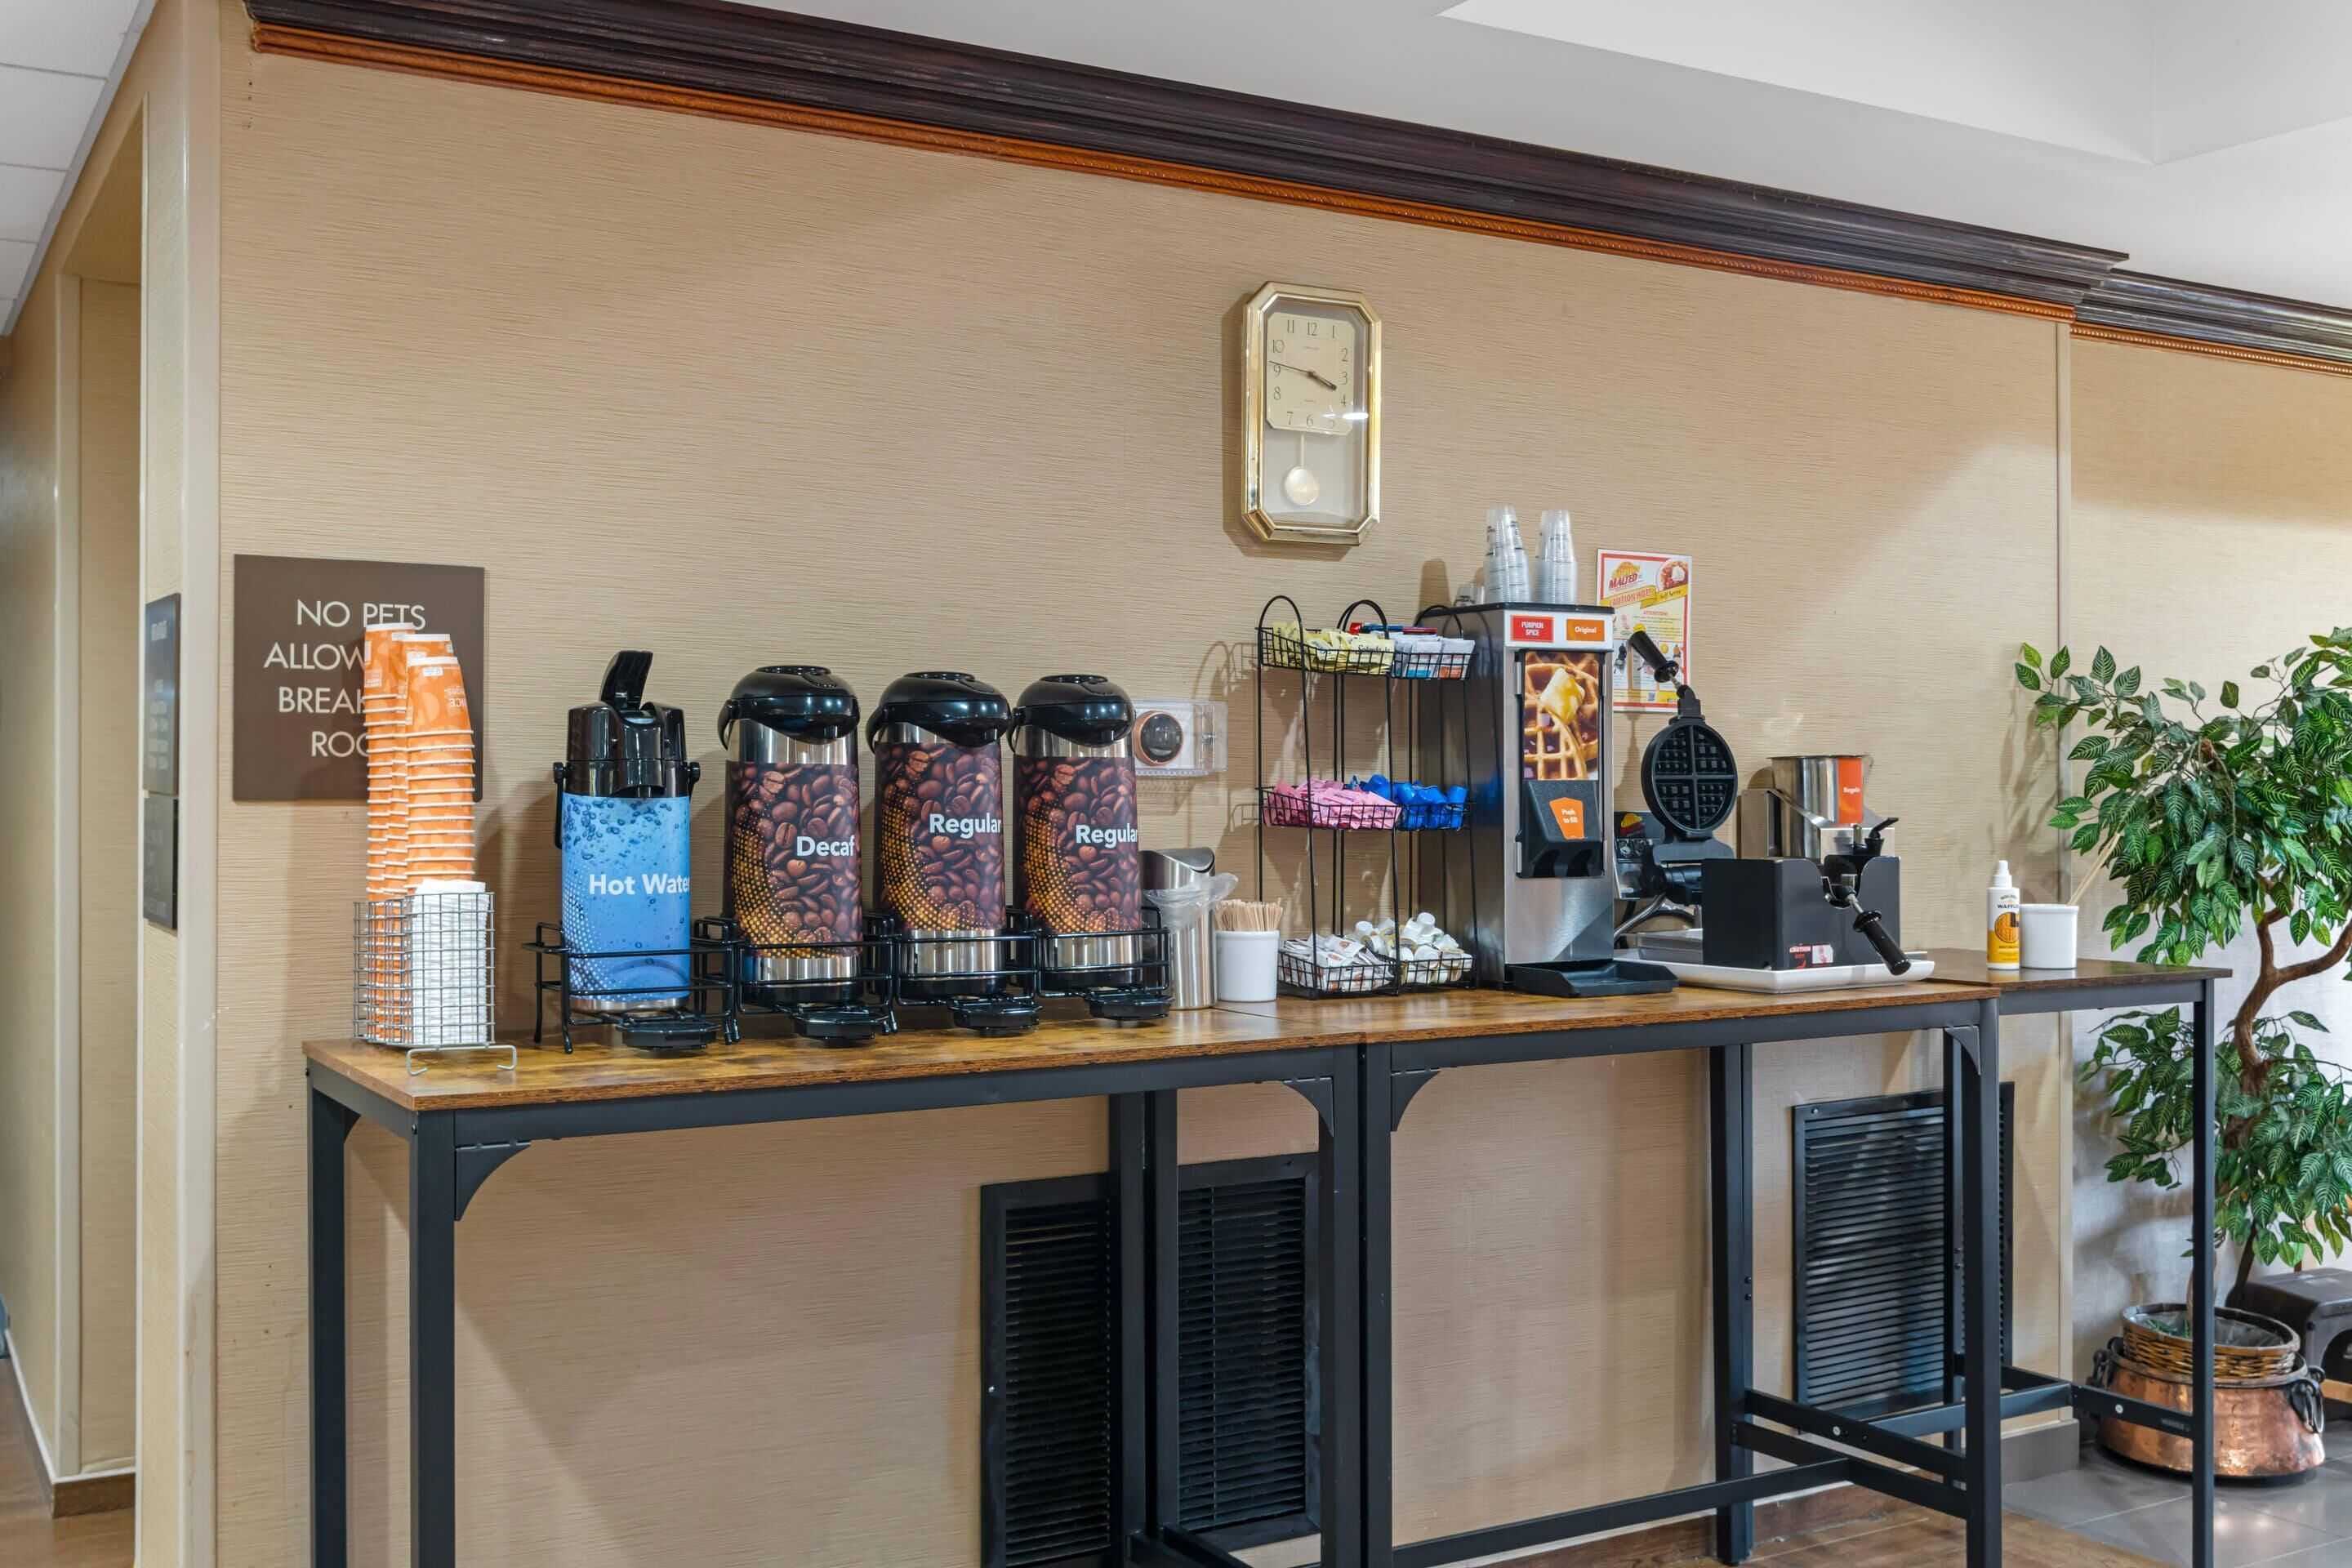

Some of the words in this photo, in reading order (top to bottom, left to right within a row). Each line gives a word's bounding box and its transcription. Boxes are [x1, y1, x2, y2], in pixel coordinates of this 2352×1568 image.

[1287, 319, 1294, 333] 11
[1307, 322, 1318, 336] 12
[1272, 339, 1285, 353] 10
[1341, 347, 1348, 362] 2
[1273, 364, 1281, 376] 9
[1339, 372, 1348, 385] 3
[1273, 386, 1281, 400] 8
[1340, 394, 1347, 408] 4
[1286, 411, 1294, 425] 7
[1306, 414, 1314, 427] 6
[1609, 573, 1638, 589] MALTED
[297, 599, 350, 627] NO
[363, 603, 425, 630] PETS
[1575, 626, 1597, 635] Original
[929, 812, 1002, 839] Regular
[1076, 822, 1138, 849] Regula
[796, 835, 855, 857] Decaf
[589, 874, 636, 895] Hot
[641, 873, 690, 894] Wate
